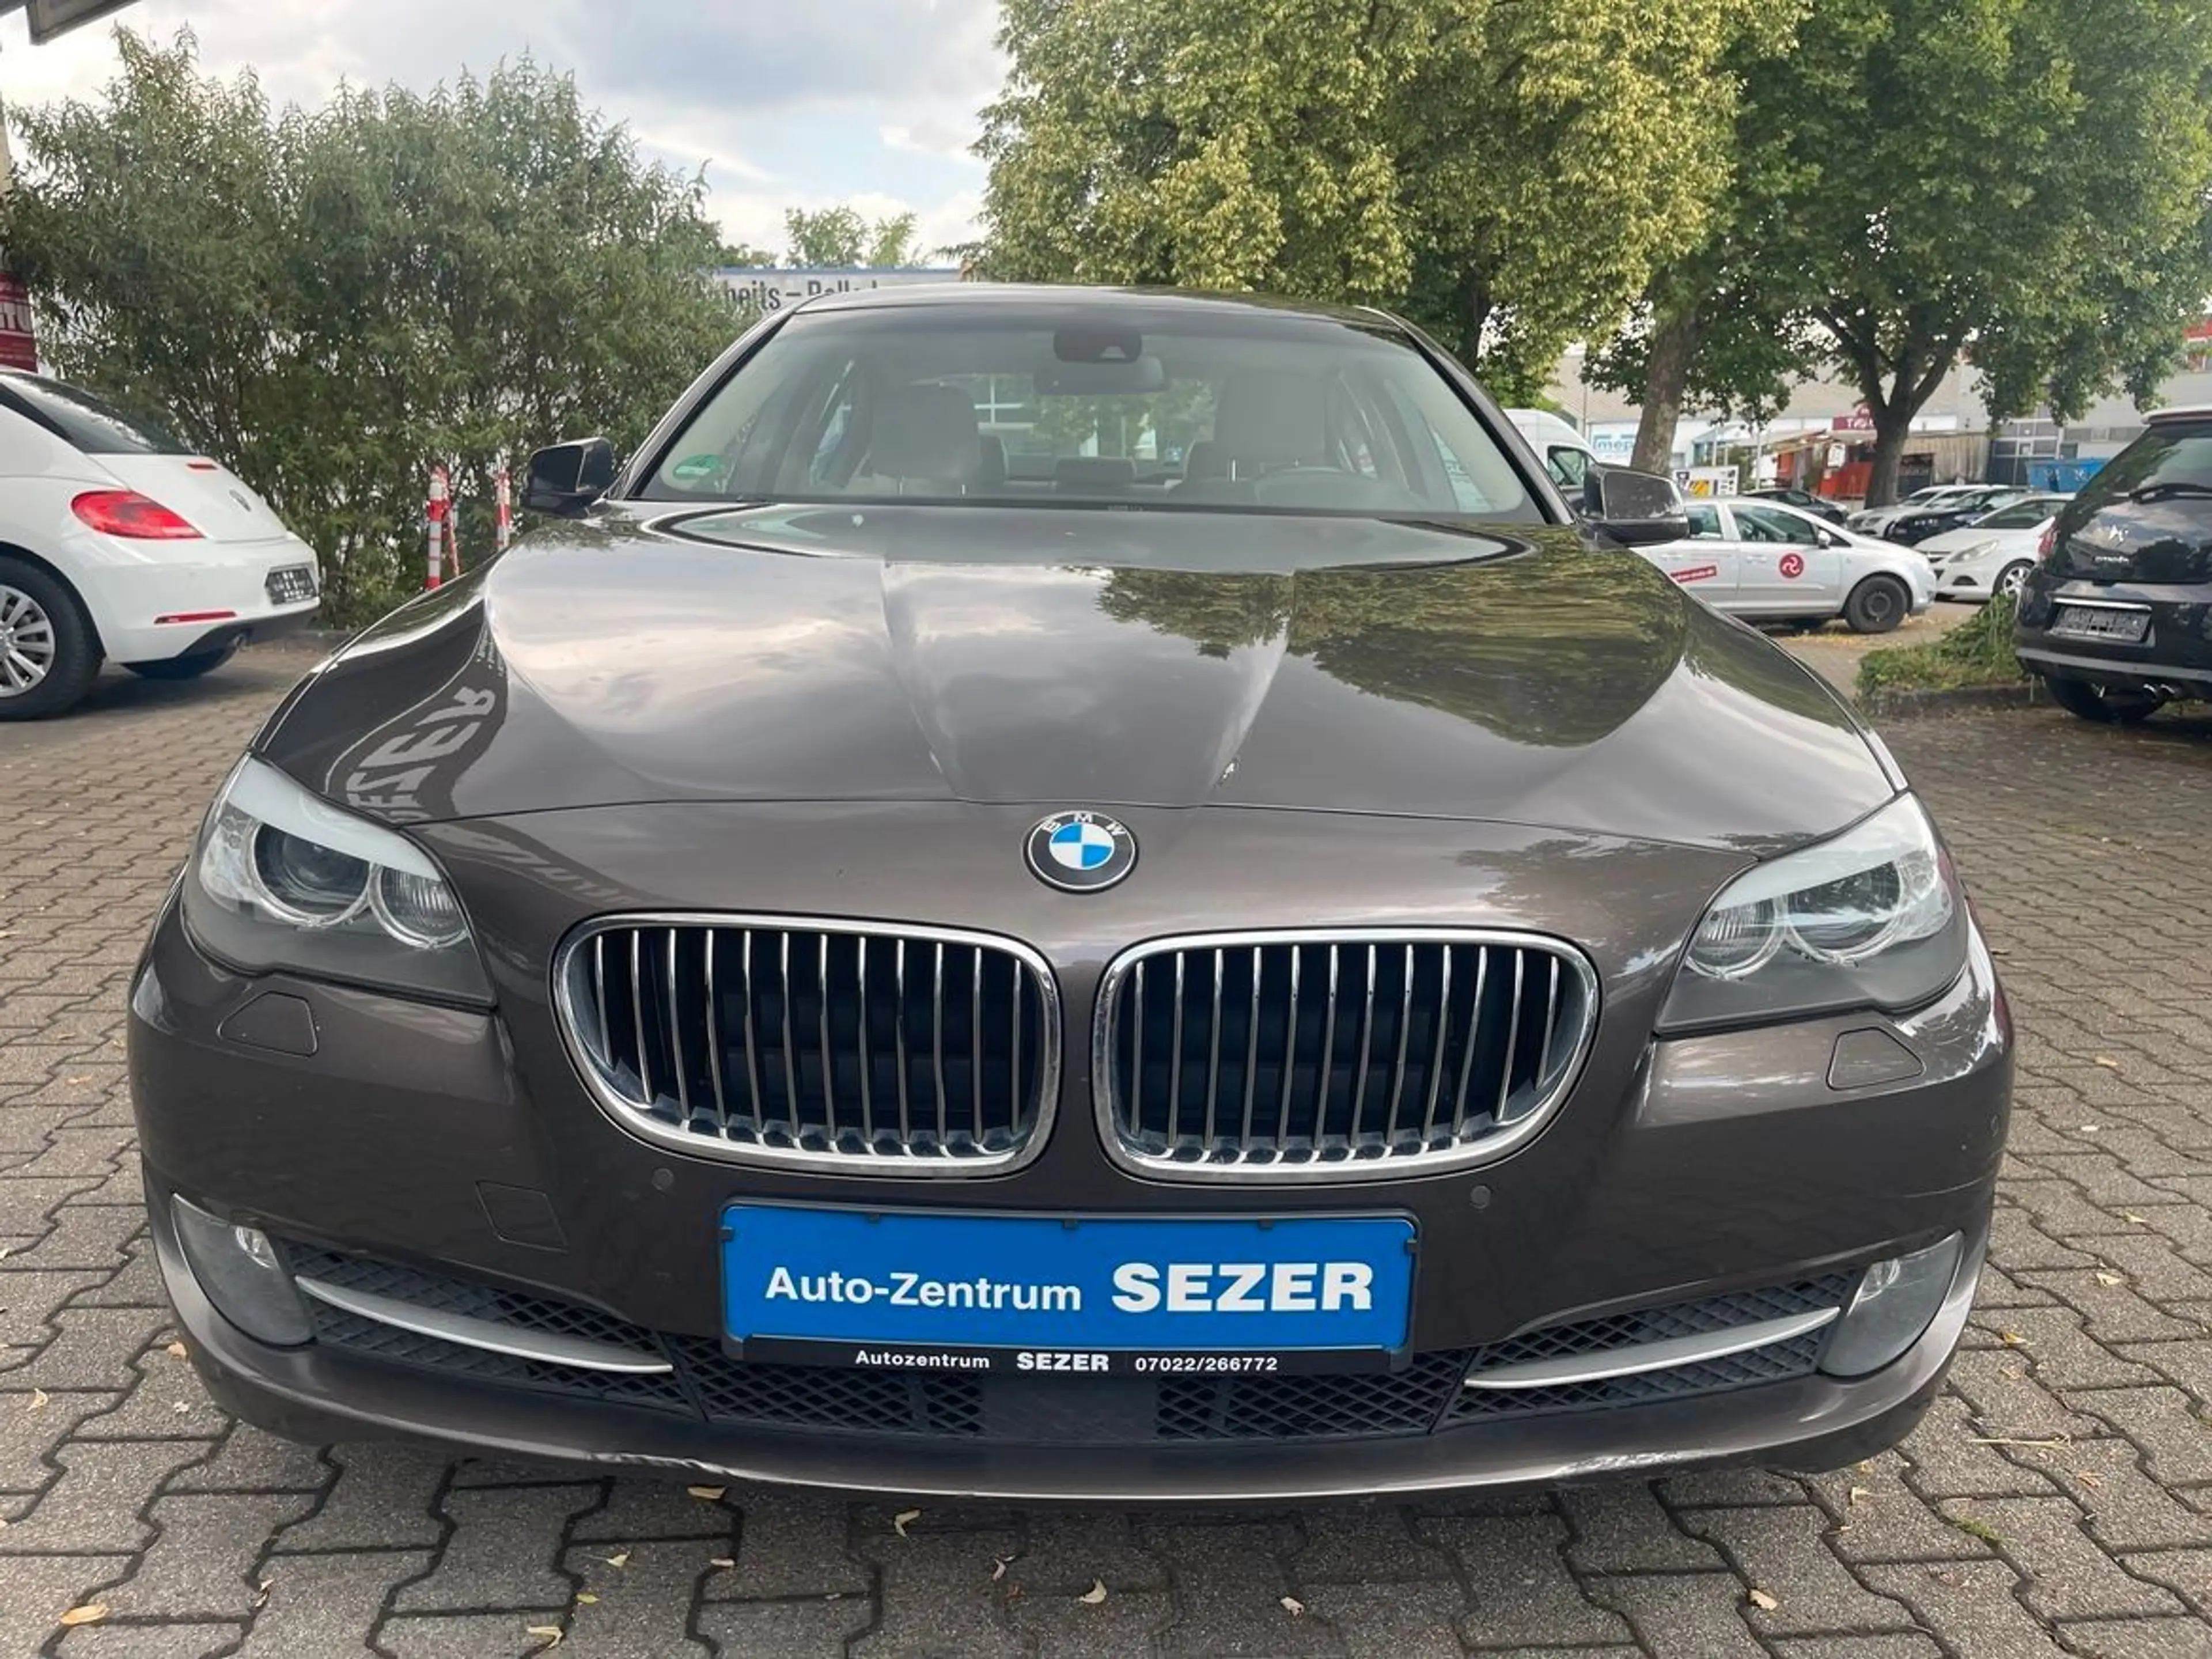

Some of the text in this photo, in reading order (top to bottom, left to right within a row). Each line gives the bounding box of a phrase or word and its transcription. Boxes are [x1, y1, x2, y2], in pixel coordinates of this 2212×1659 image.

[1042, 812, 1127, 836] BMW
[765, 1262, 1373, 1313] Auto-Zentrum SEZER
[855, 1350, 1278, 1372] Autozentrum SEZER 07022/266772
